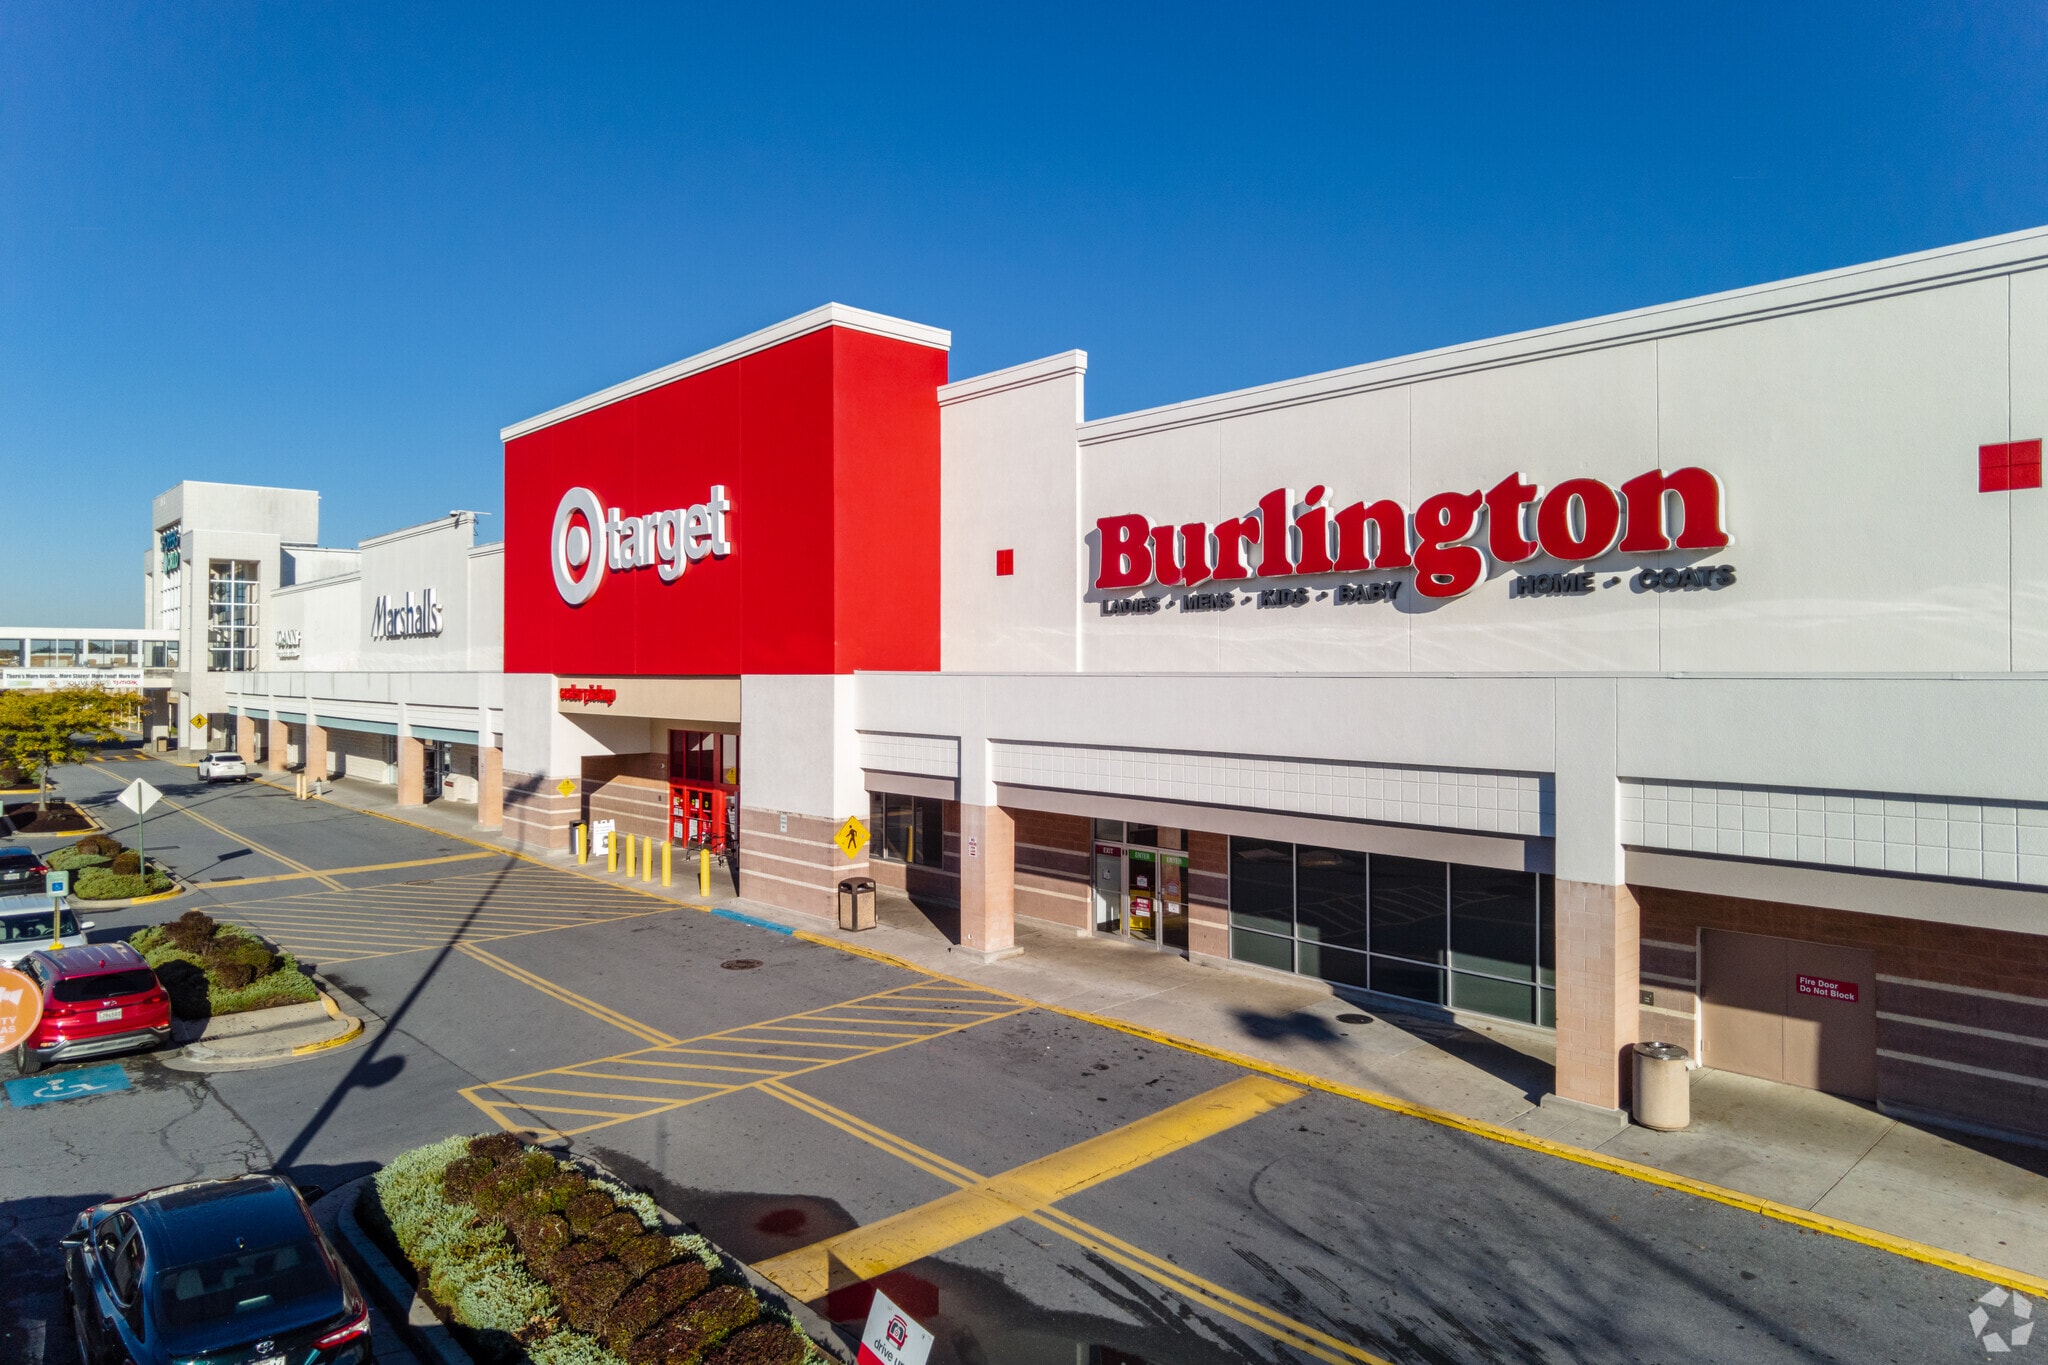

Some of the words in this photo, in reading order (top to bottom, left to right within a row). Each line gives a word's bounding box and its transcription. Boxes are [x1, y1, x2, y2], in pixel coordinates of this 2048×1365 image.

[605, 485, 731, 581] target
[1094, 466, 1735, 598] Burlington
[1515, 572, 1596, 595] HOME
[1637, 564, 1737, 590] COATS
[1102, 597, 1160, 614] LADIES
[1182, 592, 1234, 611] MENS
[1260, 588, 1309, 607] KIDS
[1338, 582, 1401, 602] BABY
[370, 587, 443, 640] Marshalls
[1103, 846, 1114, 854] EXIT
[1135, 851, 1150, 860] ENTER
[1166, 857, 1182, 865] ENTER
[1800, 976, 1816, 985] Fire
[1818, 980, 1838, 989] Door
[1800, 984, 1811, 993] Do
[1813, 987, 1828, 996] Not
[1830, 990, 1855, 1000] Block
[873, 1339, 894, 1362] drive
